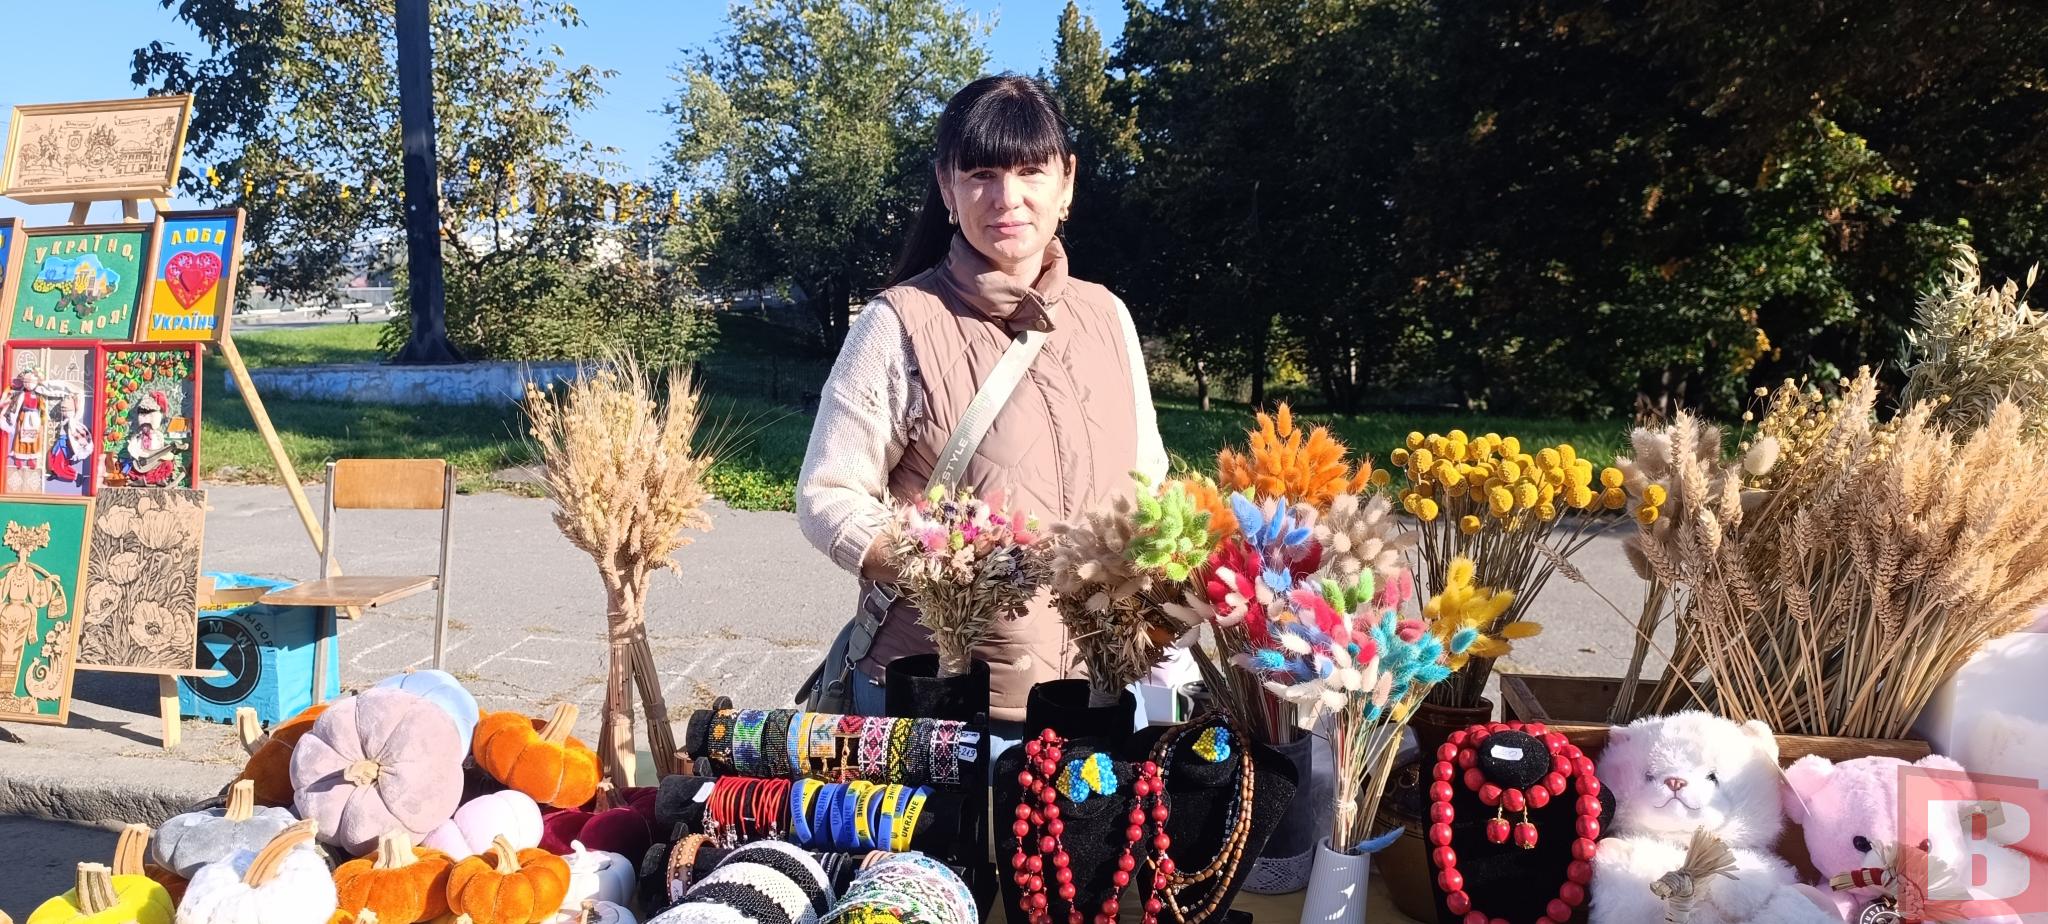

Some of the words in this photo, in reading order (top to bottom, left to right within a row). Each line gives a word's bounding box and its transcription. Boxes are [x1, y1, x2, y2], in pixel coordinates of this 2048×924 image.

[34, 234, 134, 264] УКРАЇНО,
[170, 227, 227, 246] ЛЮБИ
[21, 305, 70, 335] ДОЛЕ
[79, 303, 128, 335] МОЯ!
[942, 438, 968, 481] STYLE
[901, 800, 919, 838] UKRAINE
